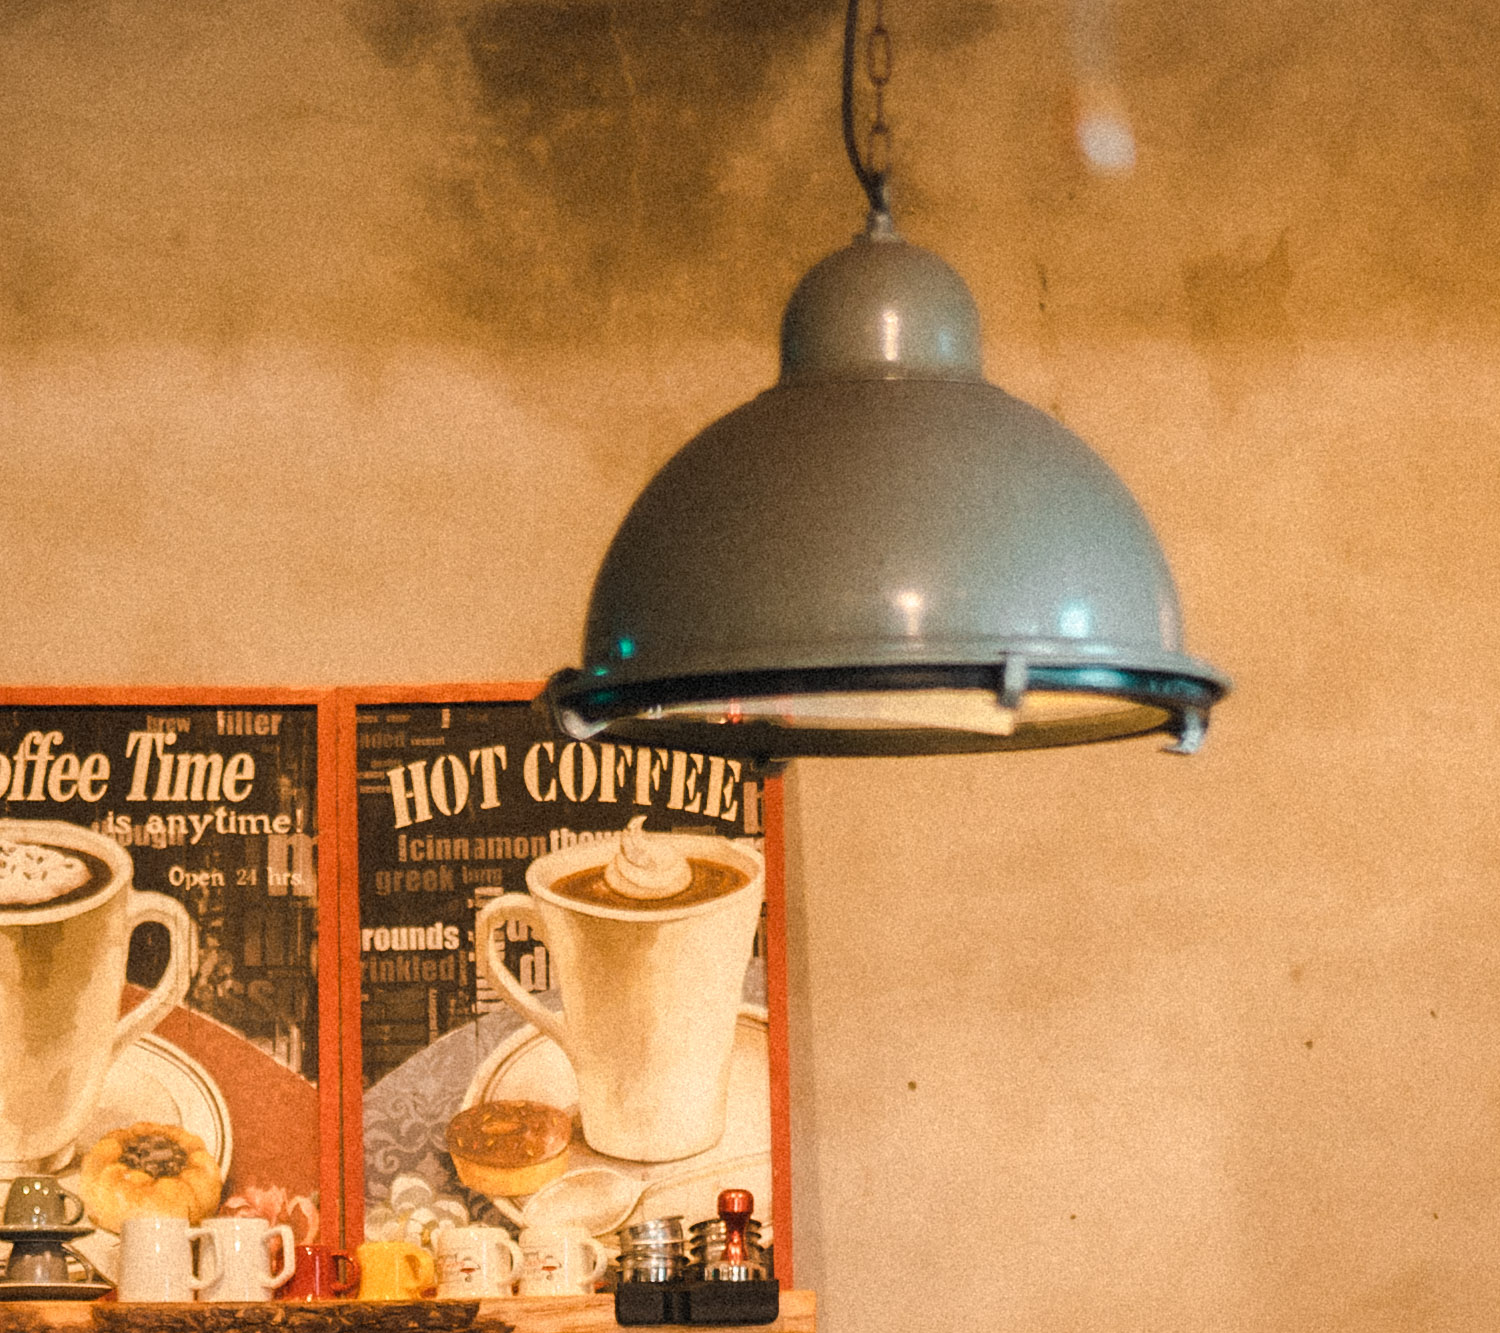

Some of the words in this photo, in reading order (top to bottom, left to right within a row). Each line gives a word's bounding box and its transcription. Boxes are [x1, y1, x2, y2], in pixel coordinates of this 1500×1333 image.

[125, 731, 256, 802] Time
[387, 746, 507, 829] HOT
[523, 742, 742, 822] COFFEE
[106, 810, 132, 835] is
[146, 805, 304, 845] anytime!
[168, 865, 225, 891] Open
[376, 866, 454, 896] greek
[361, 922, 460, 951] rounds
